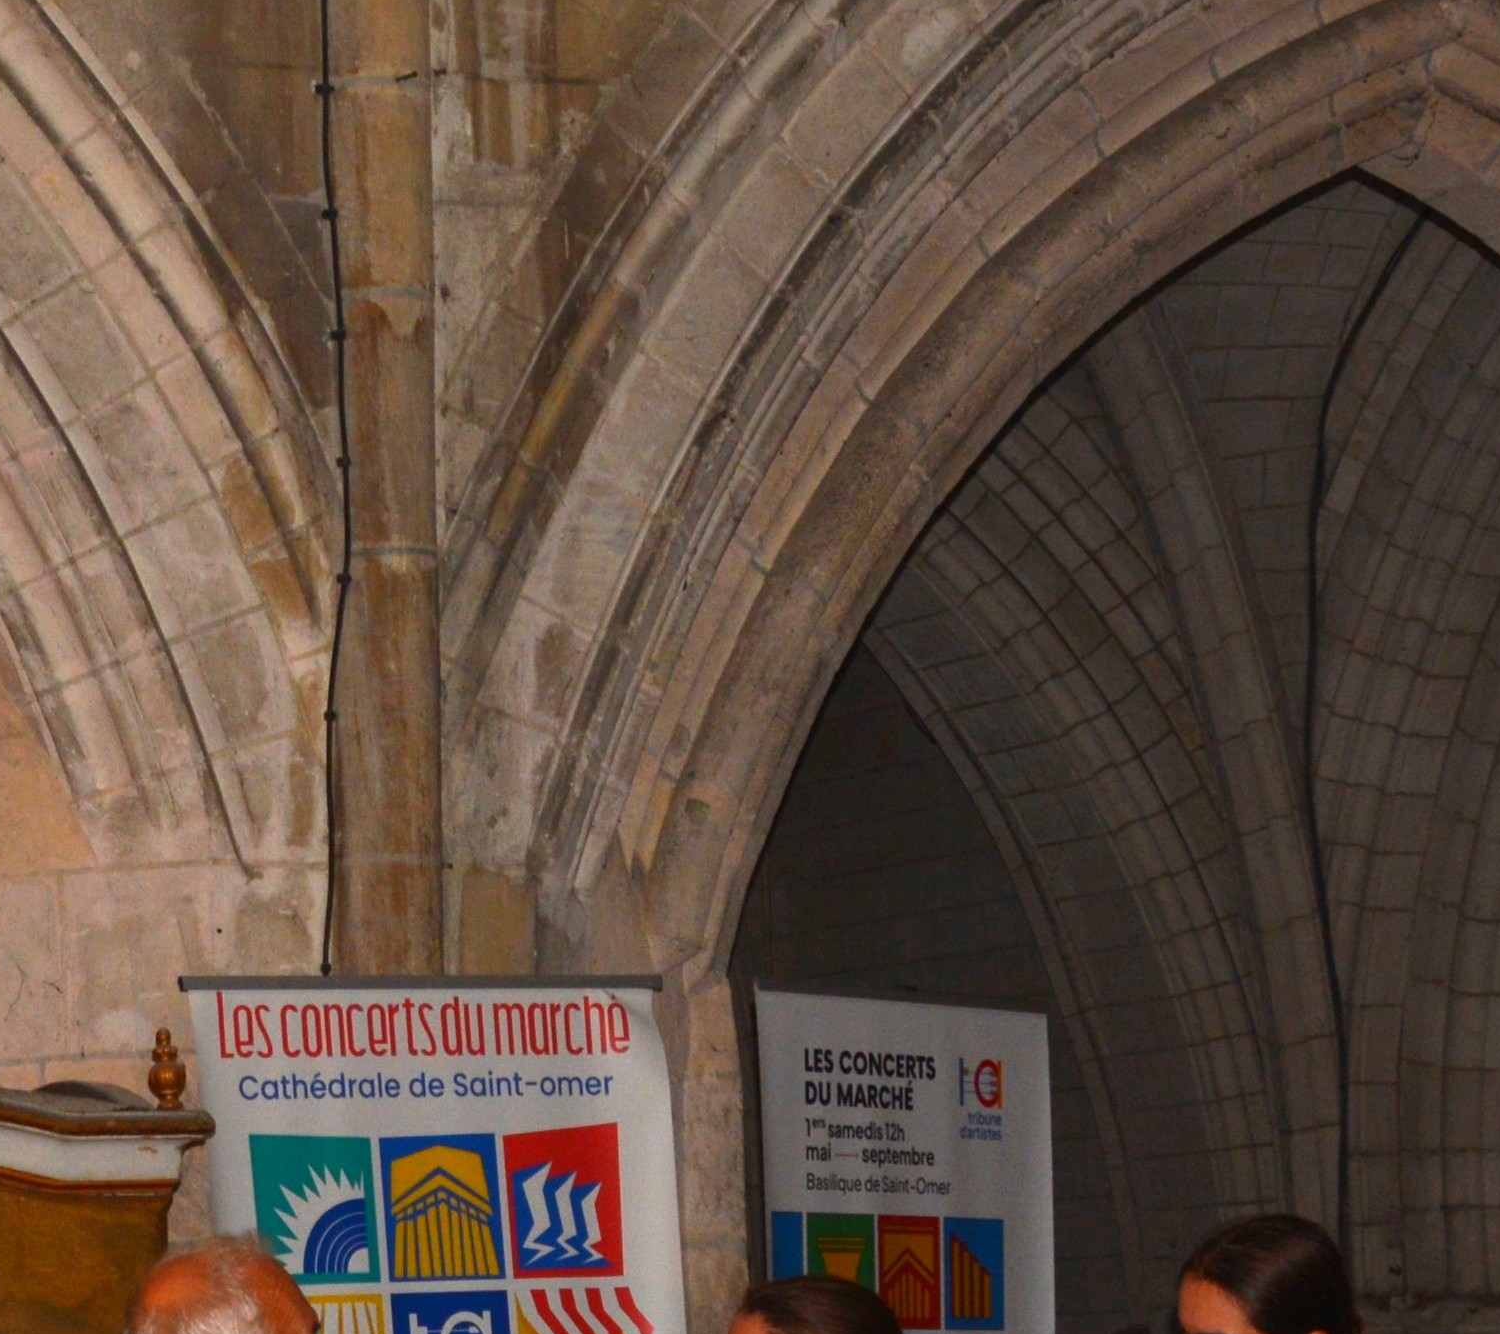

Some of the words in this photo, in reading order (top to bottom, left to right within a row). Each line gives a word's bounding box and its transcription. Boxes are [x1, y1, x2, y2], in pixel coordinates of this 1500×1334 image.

[217, 991, 273, 1059] Les
[280, 995, 437, 1058] concerts
[440, 996, 487, 1055] du
[493, 993, 631, 1055] marché
[804, 1048, 834, 1073] LES
[839, 1051, 936, 1080] CONCERTS
[239, 1072, 400, 1101] Cathédrale
[409, 1073, 445, 1098] de
[454, 1071, 614, 1099] Saint-omer
[805, 1081, 831, 1106] DU
[837, 1080, 914, 1111] MARCHÉ
[828, 1122, 883, 1142] samedis
[886, 1123, 905, 1142] 12h
[806, 1143, 831, 1162] mai
[862, 1146, 935, 1167] septembre
[806, 1172, 861, 1195] Basilique
[865, 1175, 880, 1193] de
[883, 1176, 951, 1195] Saint-Omer
